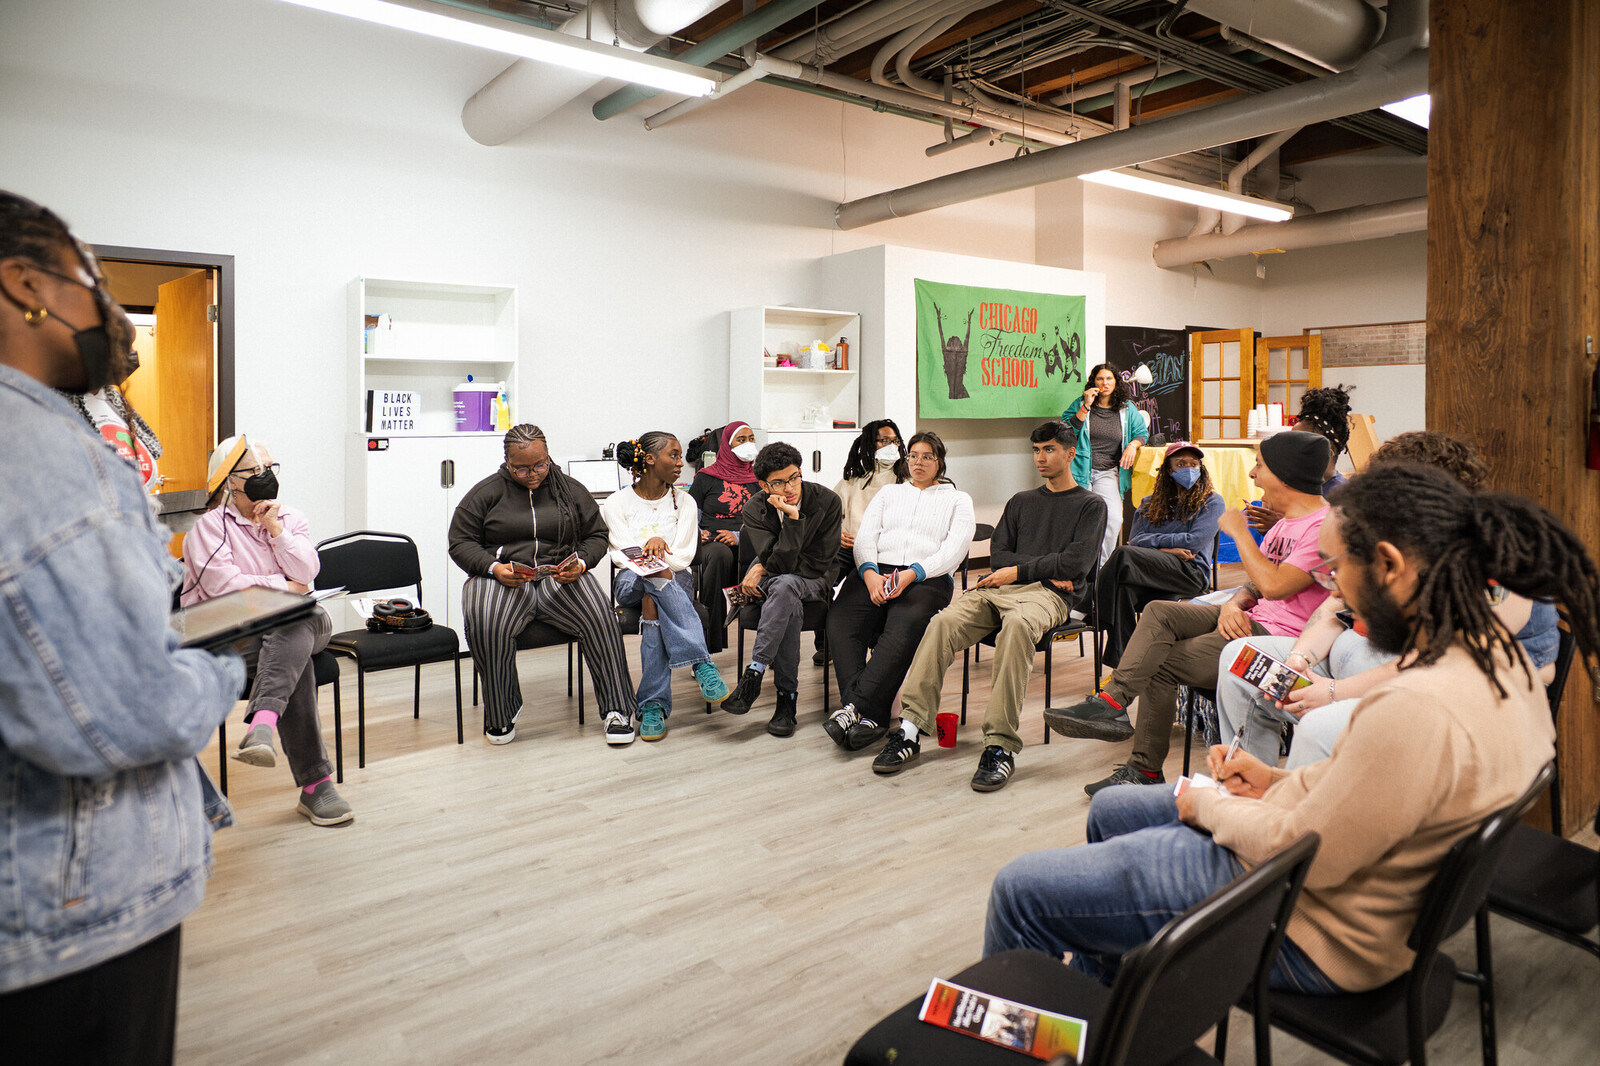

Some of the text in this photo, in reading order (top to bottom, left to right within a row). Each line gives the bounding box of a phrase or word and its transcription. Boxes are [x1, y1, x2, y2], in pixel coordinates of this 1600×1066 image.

[980, 302, 1038, 334] CHICAGO
[980, 327, 1043, 361] Freedom
[981, 357, 1038, 388] SCHOOL
[383, 393, 412, 403] BLACK
[382, 406, 411, 417] LIVES
[381, 420, 414, 430] MATTER
